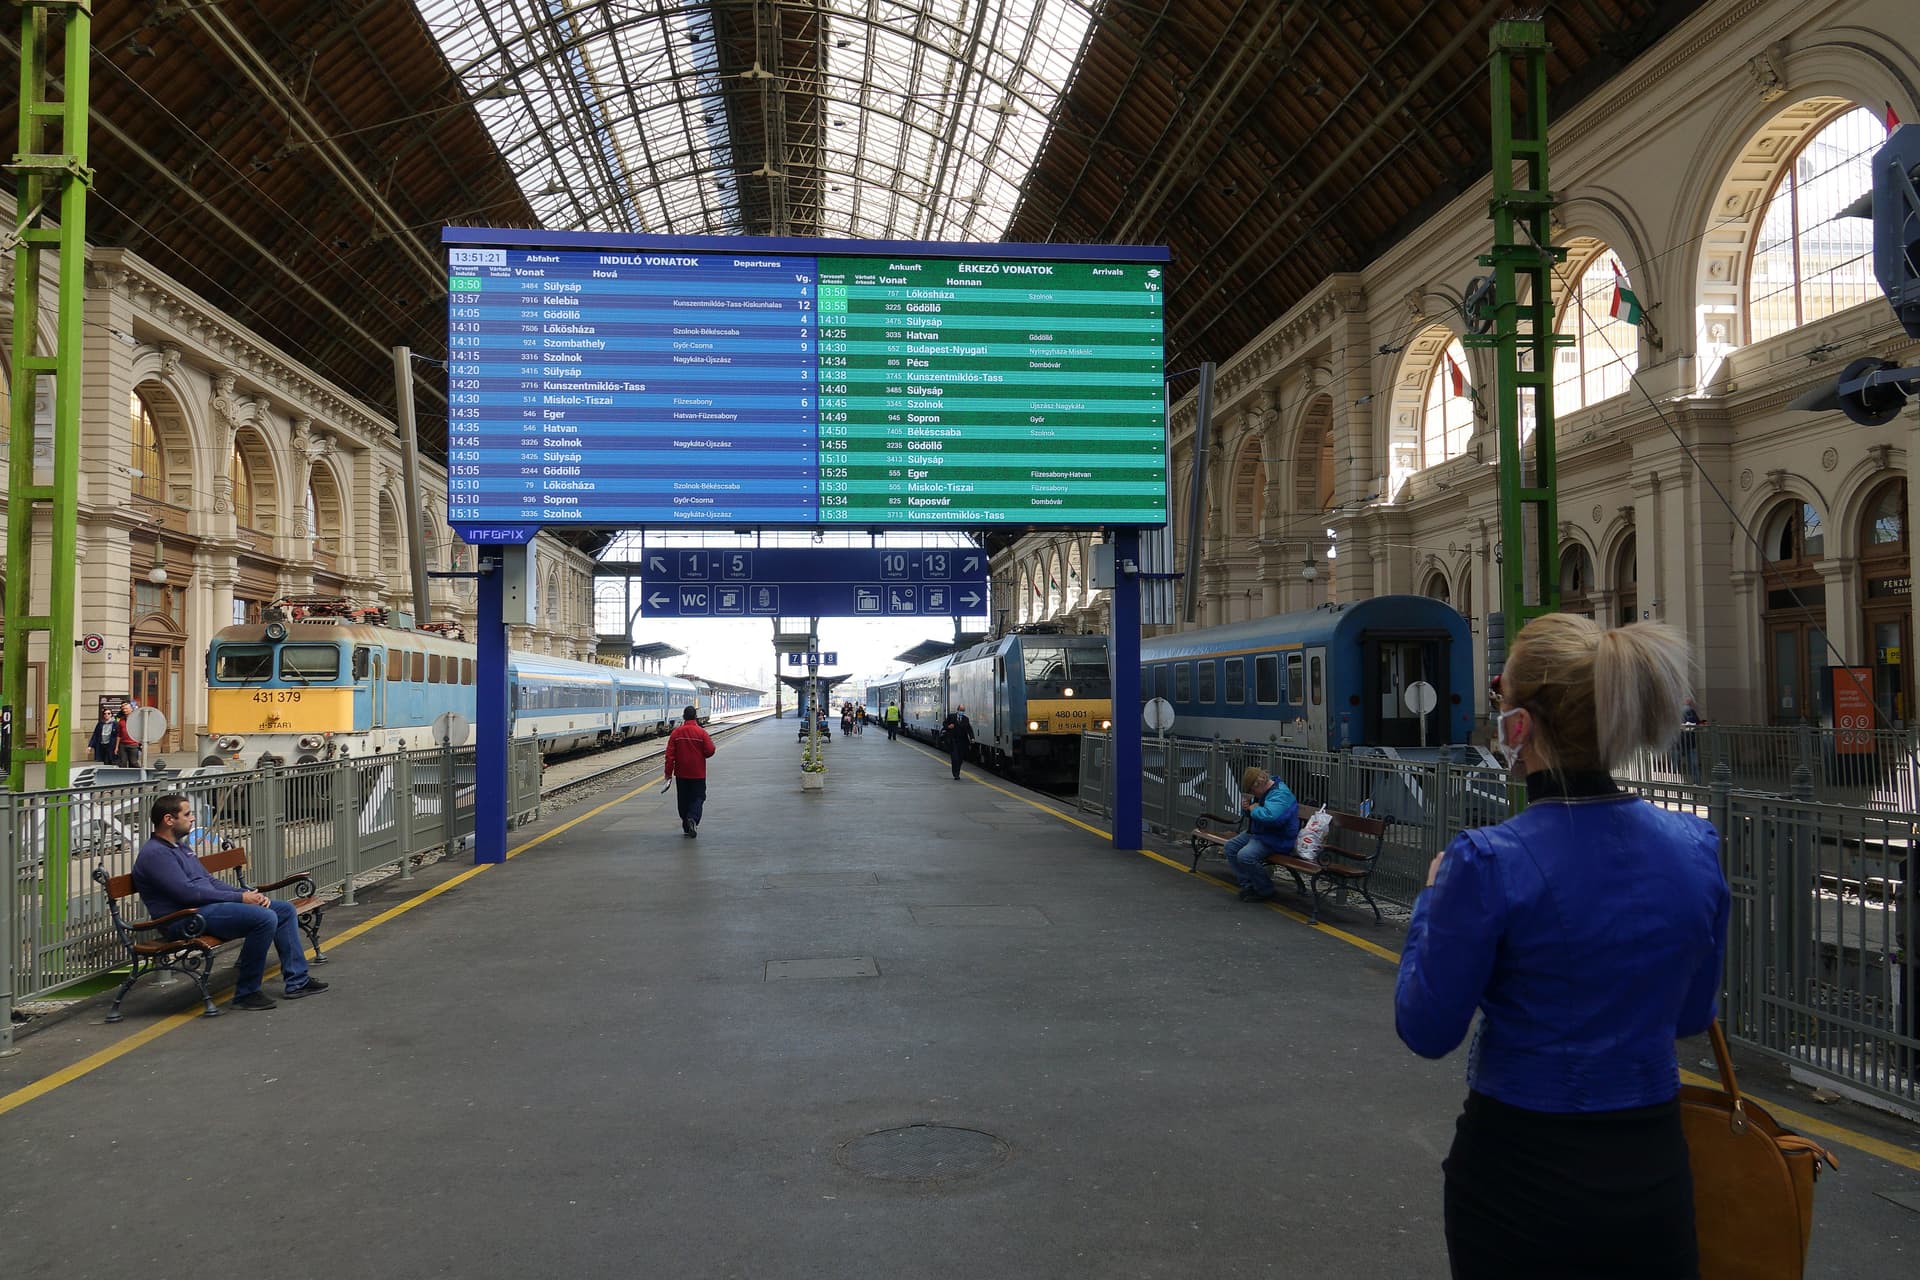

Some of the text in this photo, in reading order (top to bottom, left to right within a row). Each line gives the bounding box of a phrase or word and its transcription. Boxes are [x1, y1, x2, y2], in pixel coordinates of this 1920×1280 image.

[455, 253, 781, 268] 13:51:21 Abfahrt INDULÓ VONATOK Departures
[515, 268, 811, 283] Vonat Hová Vg.
[889, 263, 1124, 276] Ankunft ÉRKEZŐ VONATOK Arrivals
[451, 280, 480, 289] 13:50
[544, 282, 582, 293] Sülysáp
[800, 287, 807, 296] 4
[879, 276, 1160, 290] Vonat Honnan Vg.
[819, 287, 846, 296] 13:50
[906, 289, 954, 299] Lőkösháza
[1150, 294, 1154, 303] 1
[452, 294, 480, 303] 13:57
[544, 296, 579, 305] Kelebia
[798, 301, 810, 310] 12
[819, 301, 847, 310] 13:55
[906, 303, 941, 312] Gödöllő
[452, 308, 480, 317] 14:05
[543, 310, 580, 319] Gödöllő
[801, 315, 807, 323] 4
[820, 315, 942, 328] 14:10 Sülysáp
[452, 322, 480, 332] 14:10
[544, 324, 595, 334] Lőkösháza
[801, 329, 807, 338] 2
[820, 329, 846, 338] 14:25
[907, 331, 939, 340] Hatvan
[452, 337, 480, 346] 14:10
[544, 339, 605, 350] Szombathely
[801, 342, 807, 351] 9
[820, 343, 846, 352] 14:30
[907, 345, 987, 356] Budapest-Nyugati
[452, 351, 480, 360] 14:15
[543, 353, 582, 362] Szolnok
[820, 357, 847, 366] 14:34
[907, 358, 929, 367] Pécs
[452, 365, 479, 375] 14:20
[543, 367, 582, 378] Sülysáp
[801, 370, 807, 379] 3
[820, 371, 1003, 382] 14:38 Kunszentmiklós-Tass
[452, 380, 480, 389] 14:20
[543, 381, 645, 391] Kunszentmiklós-Tass
[820, 384, 943, 397] 14:40 Sülysáp
[452, 394, 480, 403] 14:30
[544, 395, 613, 405] Miskolc-Tiszai
[801, 398, 808, 407] 6
[820, 398, 847, 407] 14:45
[907, 400, 944, 408] Szolnok
[452, 408, 480, 418] 14:35
[544, 410, 565, 420] Eger
[820, 412, 847, 421] 14:49
[907, 414, 940, 424] Sopron
[451, 423, 479, 432] 14:35
[543, 424, 577, 432] Hatvan
[820, 426, 847, 435] 14:50
[907, 427, 961, 436] Békéscsaba
[451, 437, 479, 446] 14:45
[543, 438, 582, 447] Szolnok
[821, 440, 847, 449] 14:55
[907, 441, 942, 450] Gödöllő
[451, 451, 581, 463] 14:50 Sülysáp
[821, 454, 944, 466] 15:10 Sülysáp
[451, 465, 479, 475] 15:05
[543, 466, 580, 475] Gödöllő
[821, 468, 847, 477] 15:25
[908, 469, 928, 479] Eger
[451, 480, 479, 489] 15:10
[543, 480, 595, 489] Lőkösháza
[820, 482, 848, 491] 15:30
[908, 482, 974, 491] Miskolc-Tiszai
[451, 494, 479, 504] 15:10
[543, 495, 578, 506] Sopron
[821, 496, 847, 505] 15:34
[908, 497, 951, 507] Kaposvár
[451, 509, 479, 518] 15:15
[543, 509, 582, 518] Szolnok
[821, 510, 1005, 519] 15:38 Kunszentmiklós-Tass
[689, 555, 744, 572] 1 5
[884, 555, 946, 571] 10 13
[682, 594, 707, 607] WC
[253, 691, 301, 703] 431 379
[1056, 710, 1087, 718] 480 001
